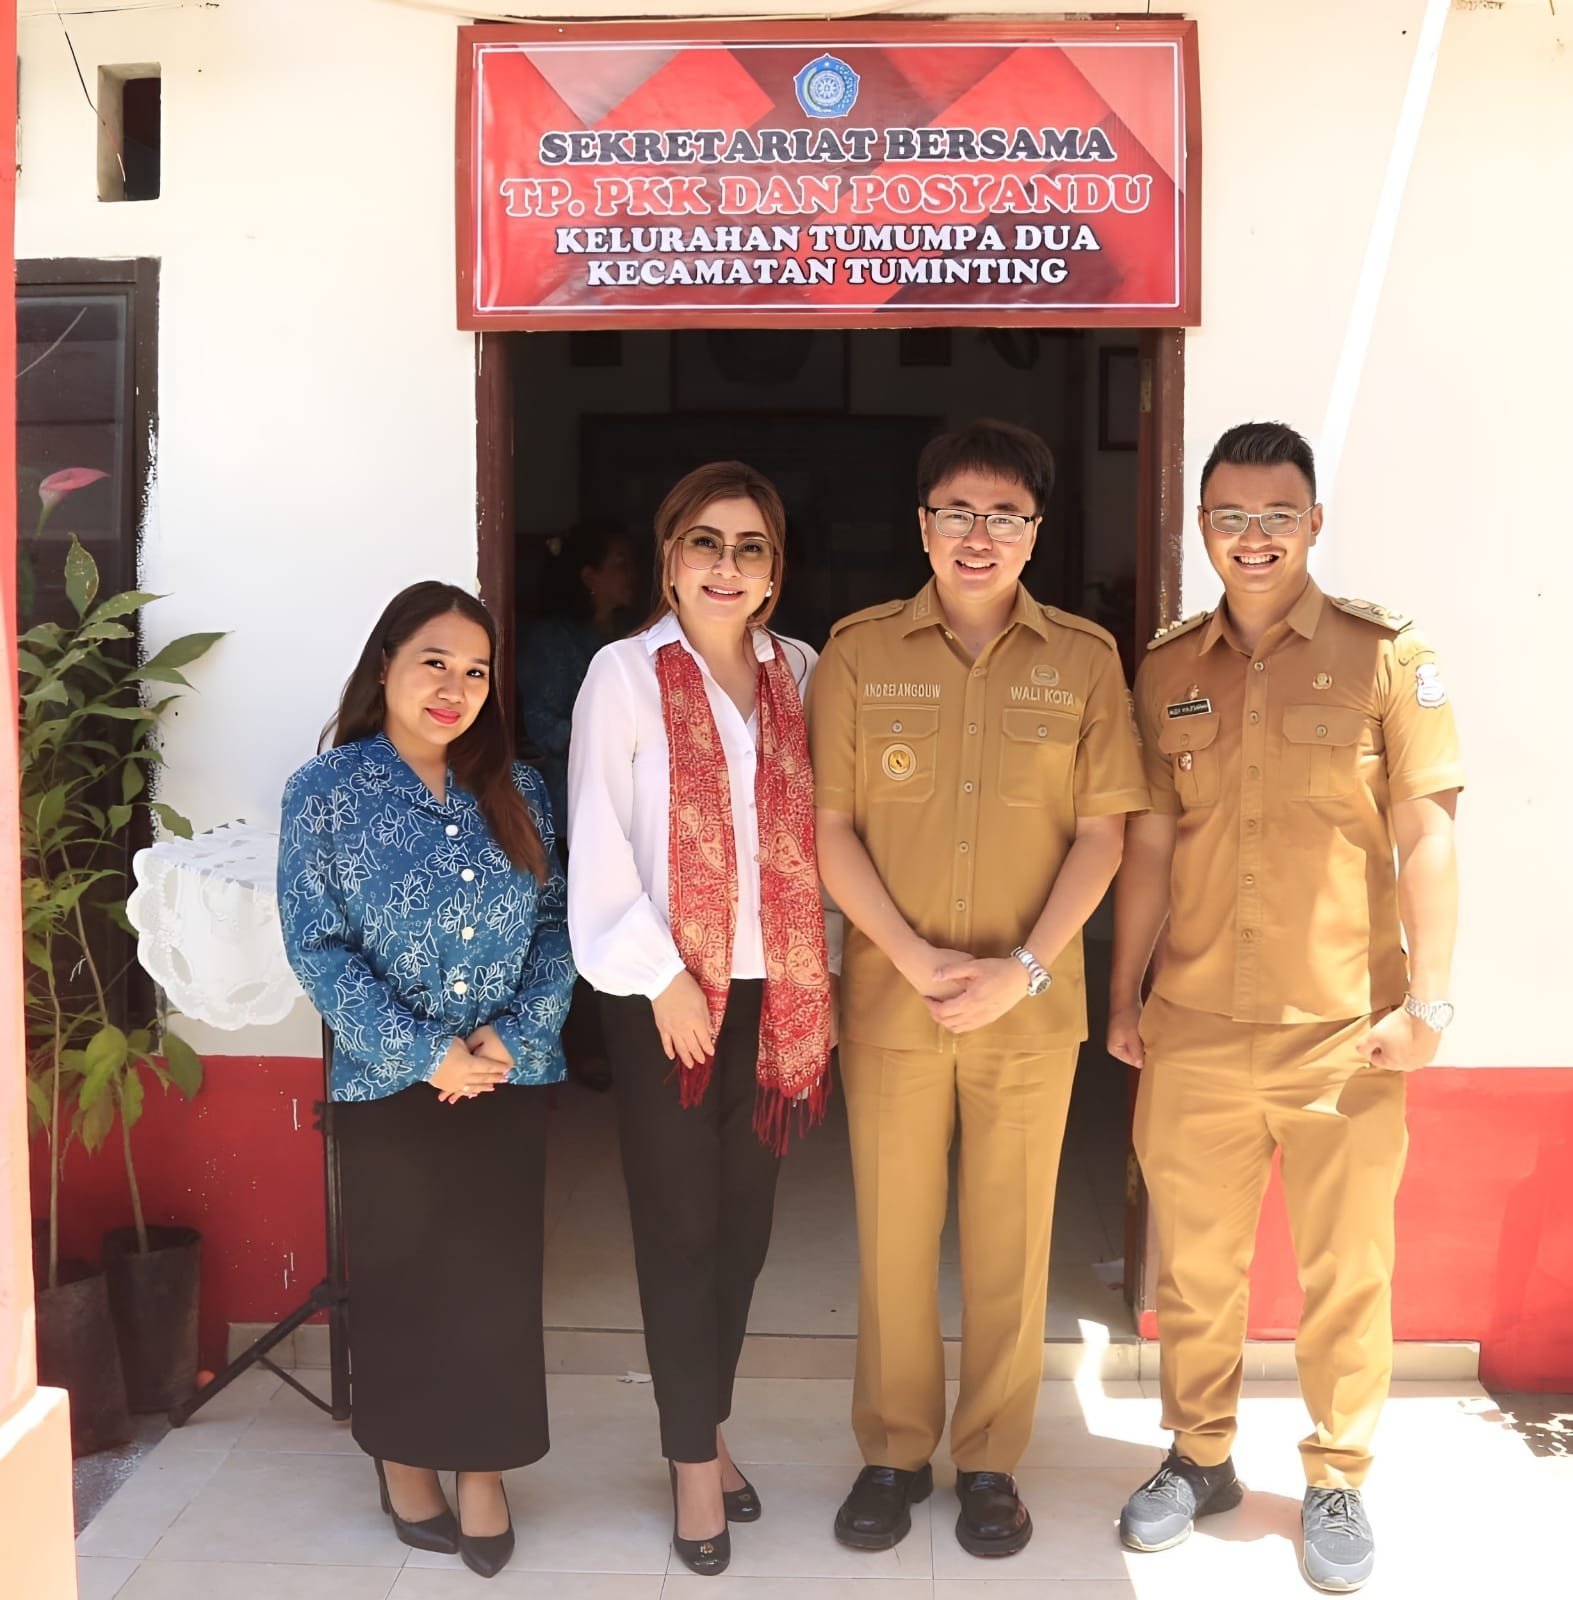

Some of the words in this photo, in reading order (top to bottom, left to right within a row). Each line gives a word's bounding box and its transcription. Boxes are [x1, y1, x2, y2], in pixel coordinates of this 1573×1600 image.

[539, 128, 878, 165] SEKRETARIAT
[885, 127, 1117, 162] BERSAMA
[501, 177, 585, 217] TP.
[594, 175, 711, 216] PKK
[719, 175, 841, 215] DAN
[850, 173, 1153, 214] POSYANDU
[555, 226, 800, 254] KELURAHAN
[808, 224, 1006, 252] TUMUMPA
[1014, 224, 1101, 251] DUA
[587, 257, 836, 286] KECAMATAN
[844, 257, 1069, 285] TUMINTING
[898, 683, 941, 698] ANGOUW
[1010, 686, 1041, 701] WALI
[1044, 688, 1075, 705] KOTA
